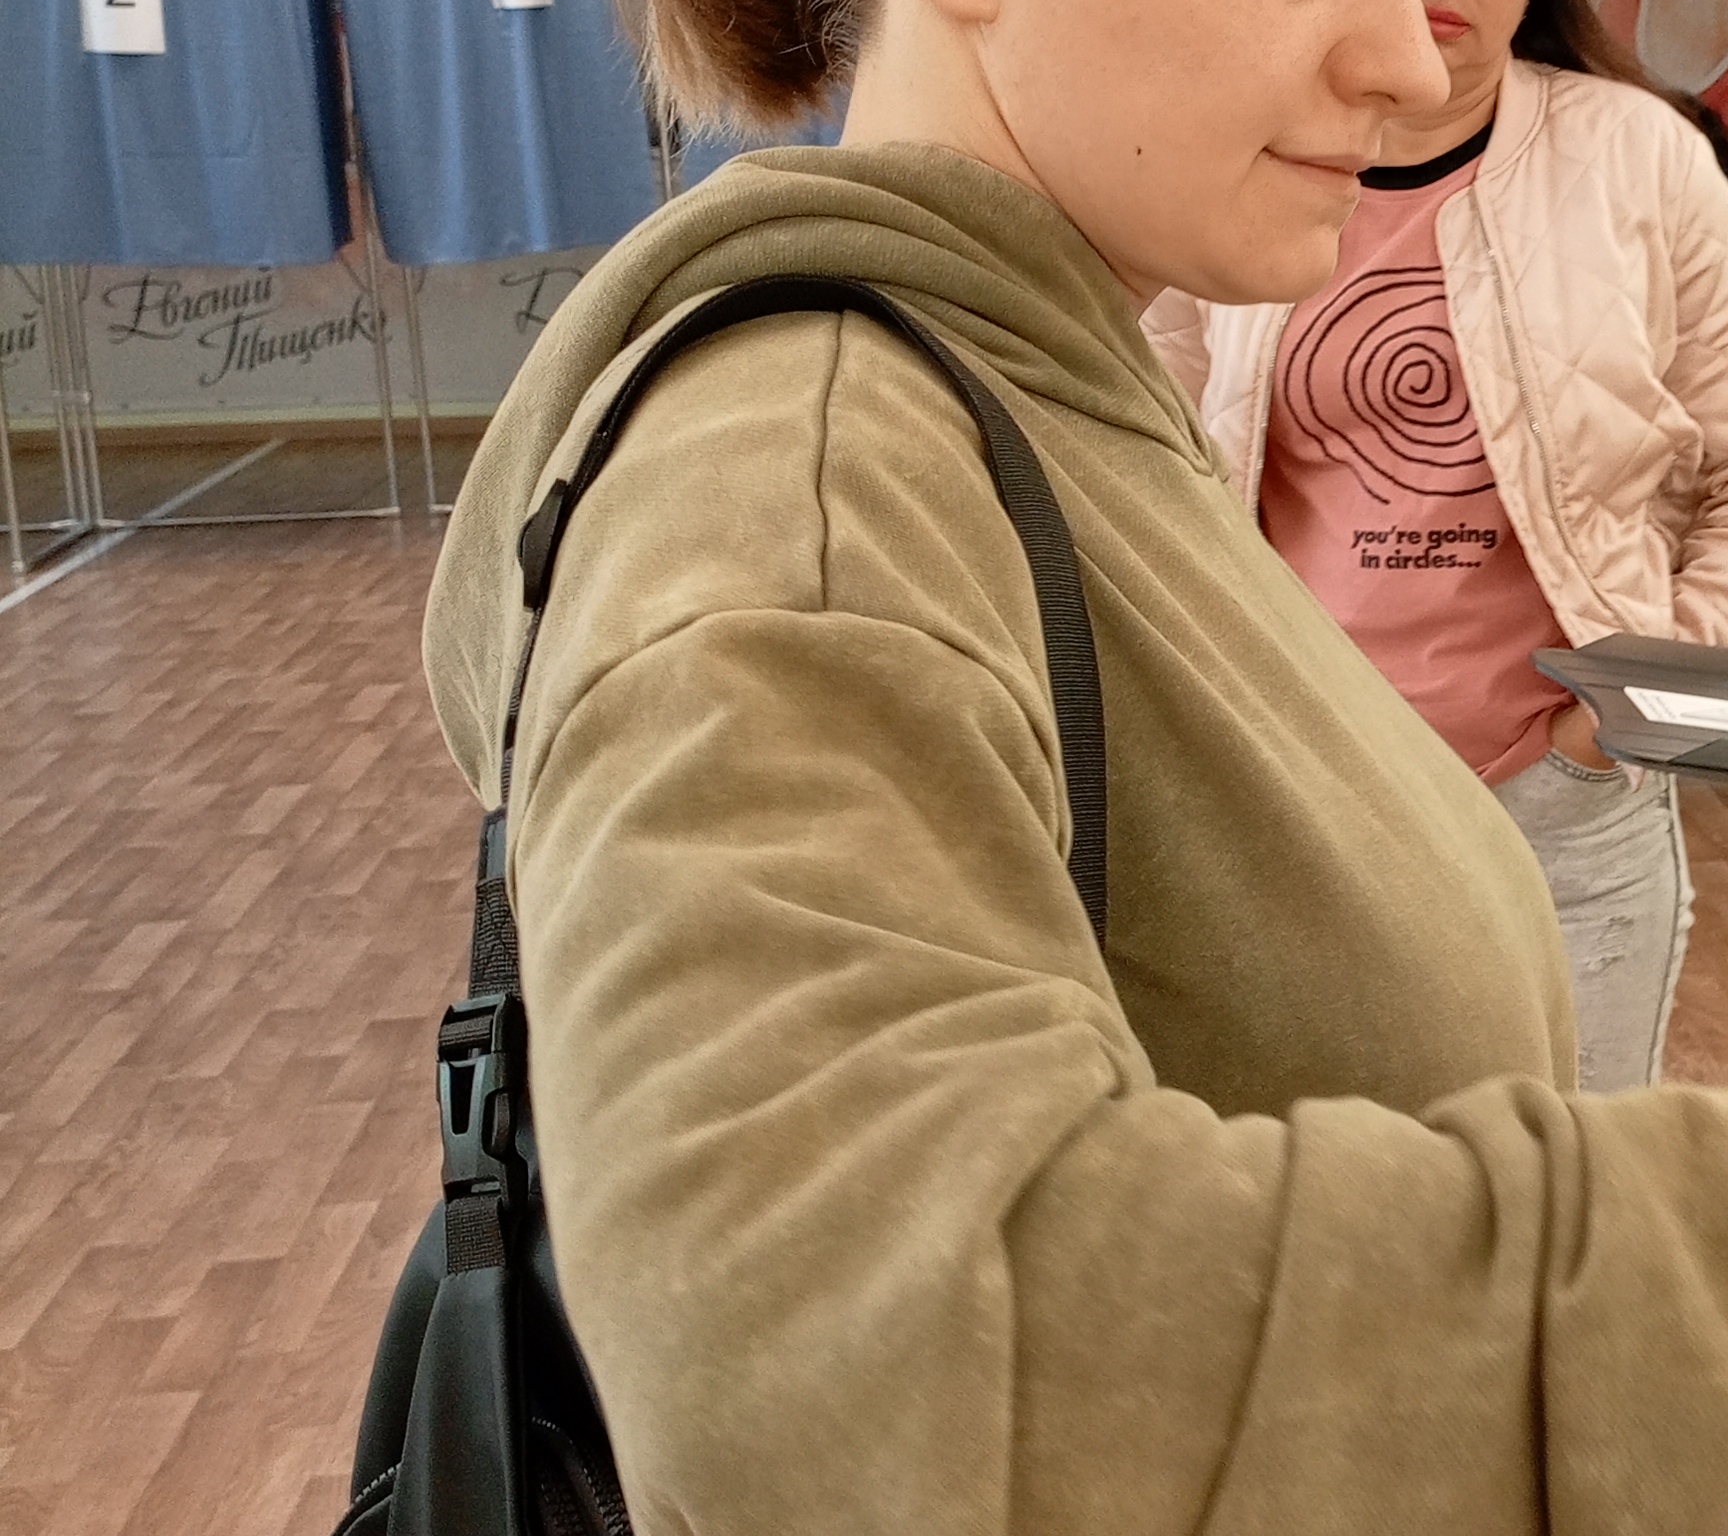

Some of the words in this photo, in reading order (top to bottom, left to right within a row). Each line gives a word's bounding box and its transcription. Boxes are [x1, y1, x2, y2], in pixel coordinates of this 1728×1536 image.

[103, 267, 273, 344] Евгений
[1351, 525, 1422, 550] you're
[1427, 522, 1498, 550] going
[1360, 548, 1381, 569] in
[1385, 547, 1482, 570] circles...
